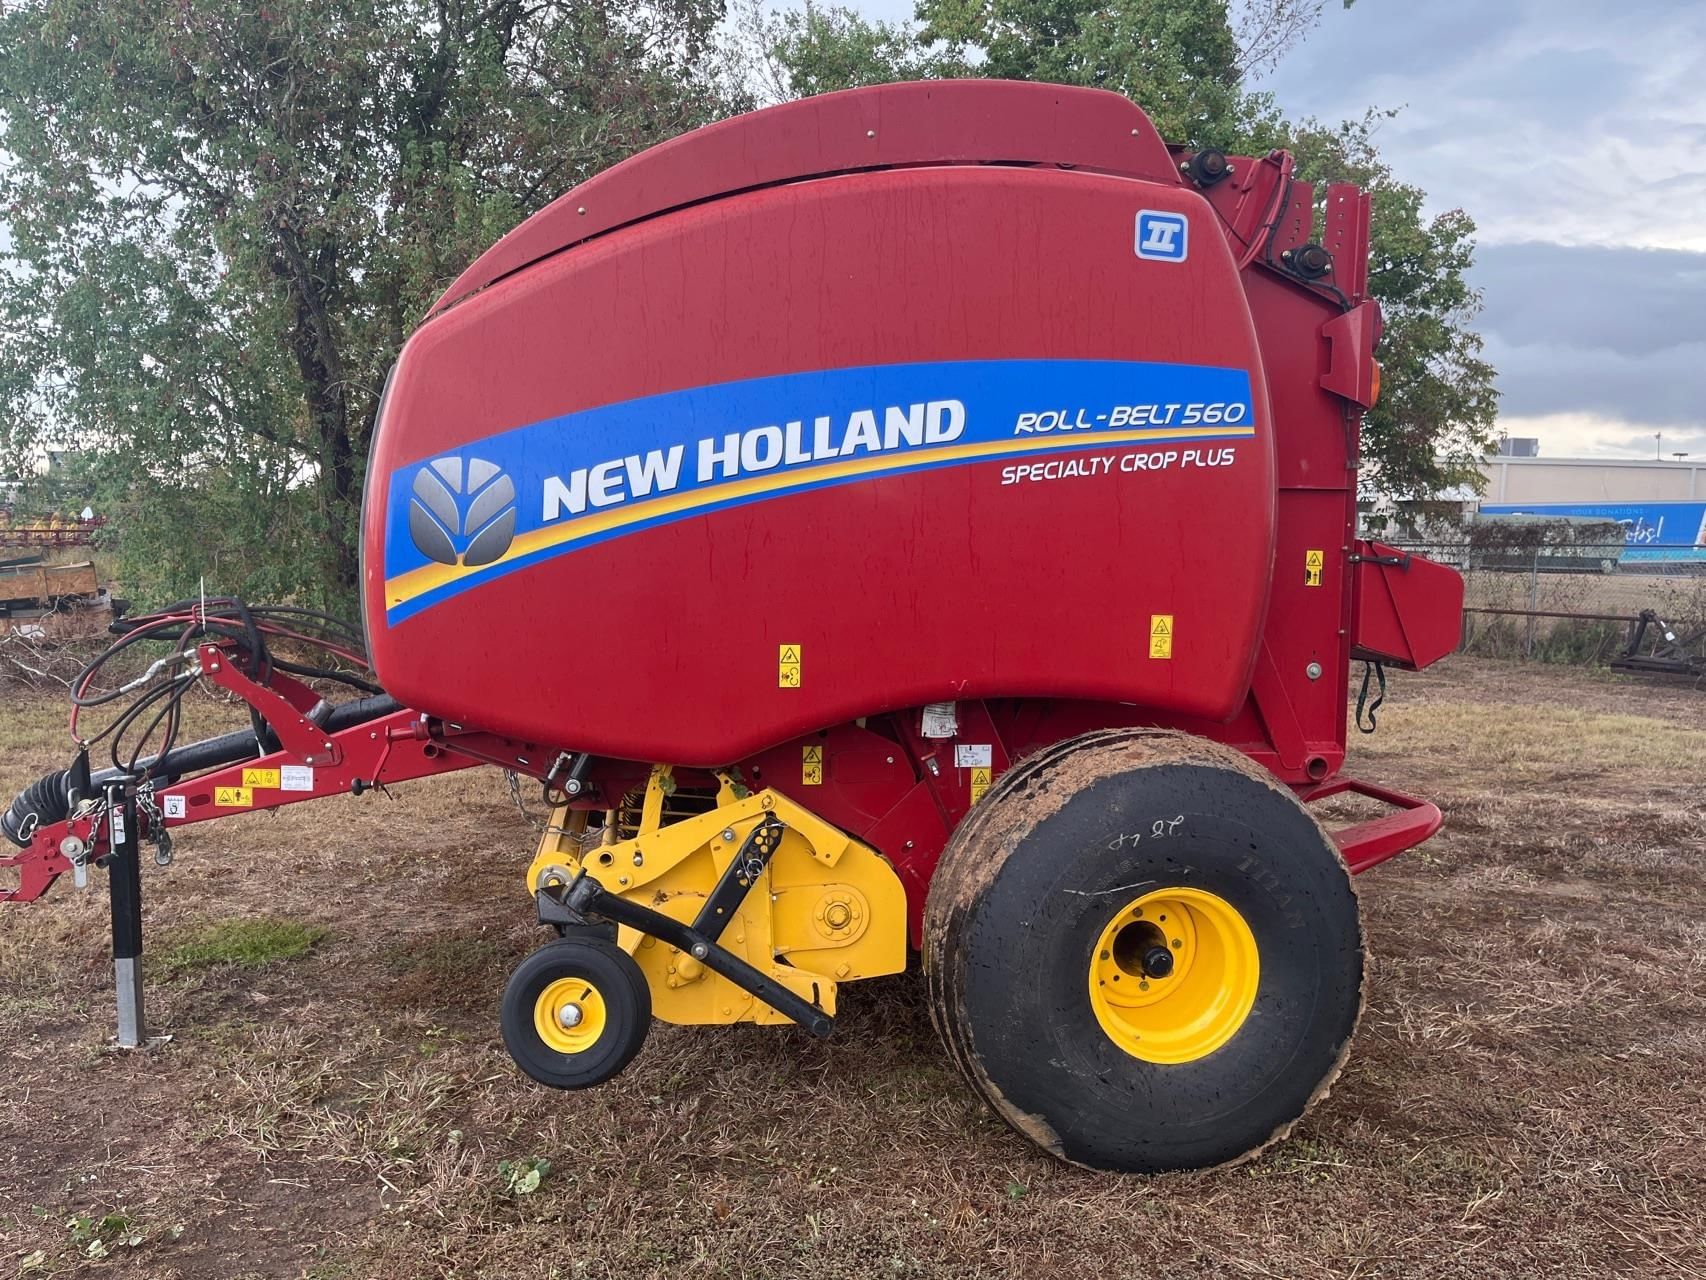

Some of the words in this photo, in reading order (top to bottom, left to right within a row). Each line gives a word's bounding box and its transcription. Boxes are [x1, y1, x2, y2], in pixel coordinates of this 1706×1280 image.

[1181, 403, 1246, 425] 560
[542, 446, 685, 522] NEW
[698, 399, 967, 482] HOLLAND
[1001, 456, 1116, 485] SPECIALTY
[1120, 451, 1178, 473] CROP
[1181, 448, 1235, 468] PLUS
